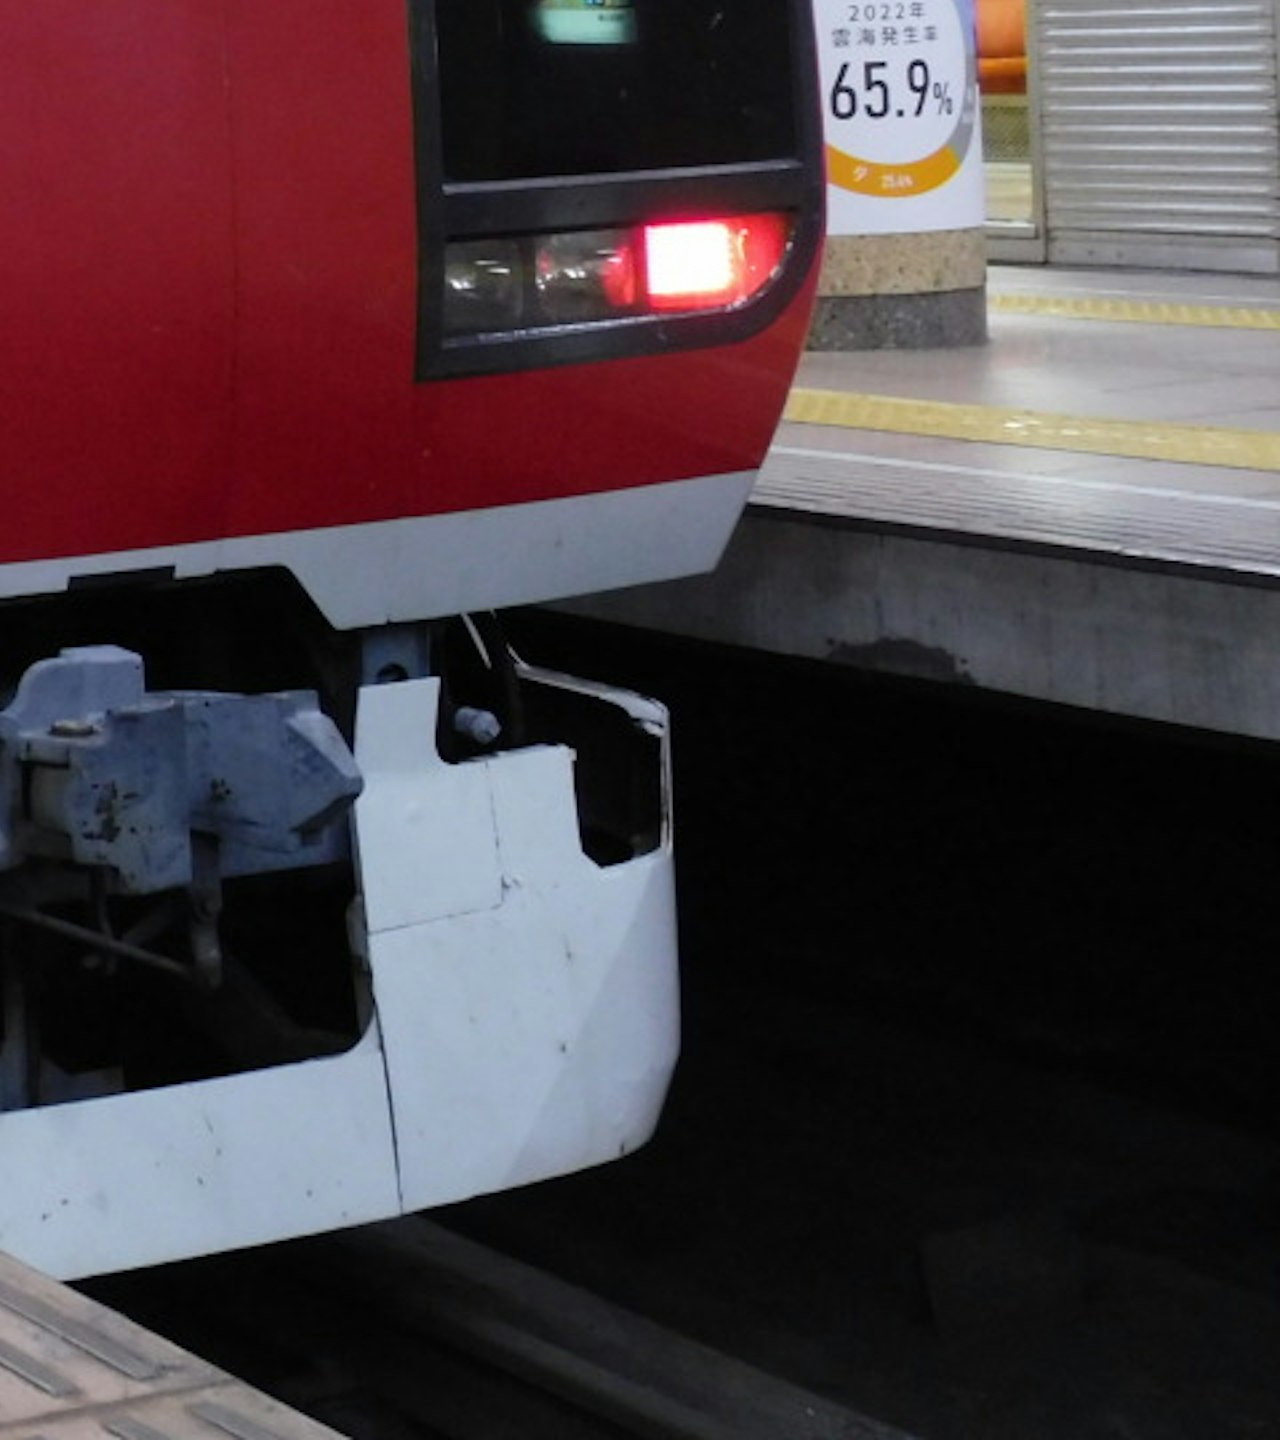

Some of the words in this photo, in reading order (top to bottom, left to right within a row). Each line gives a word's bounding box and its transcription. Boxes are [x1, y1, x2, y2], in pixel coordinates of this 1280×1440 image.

[848, 1, 925, 21] 2022年
[831, 25, 938, 47] 雲海発生率
[830, 58, 953, 120] 65.9%
